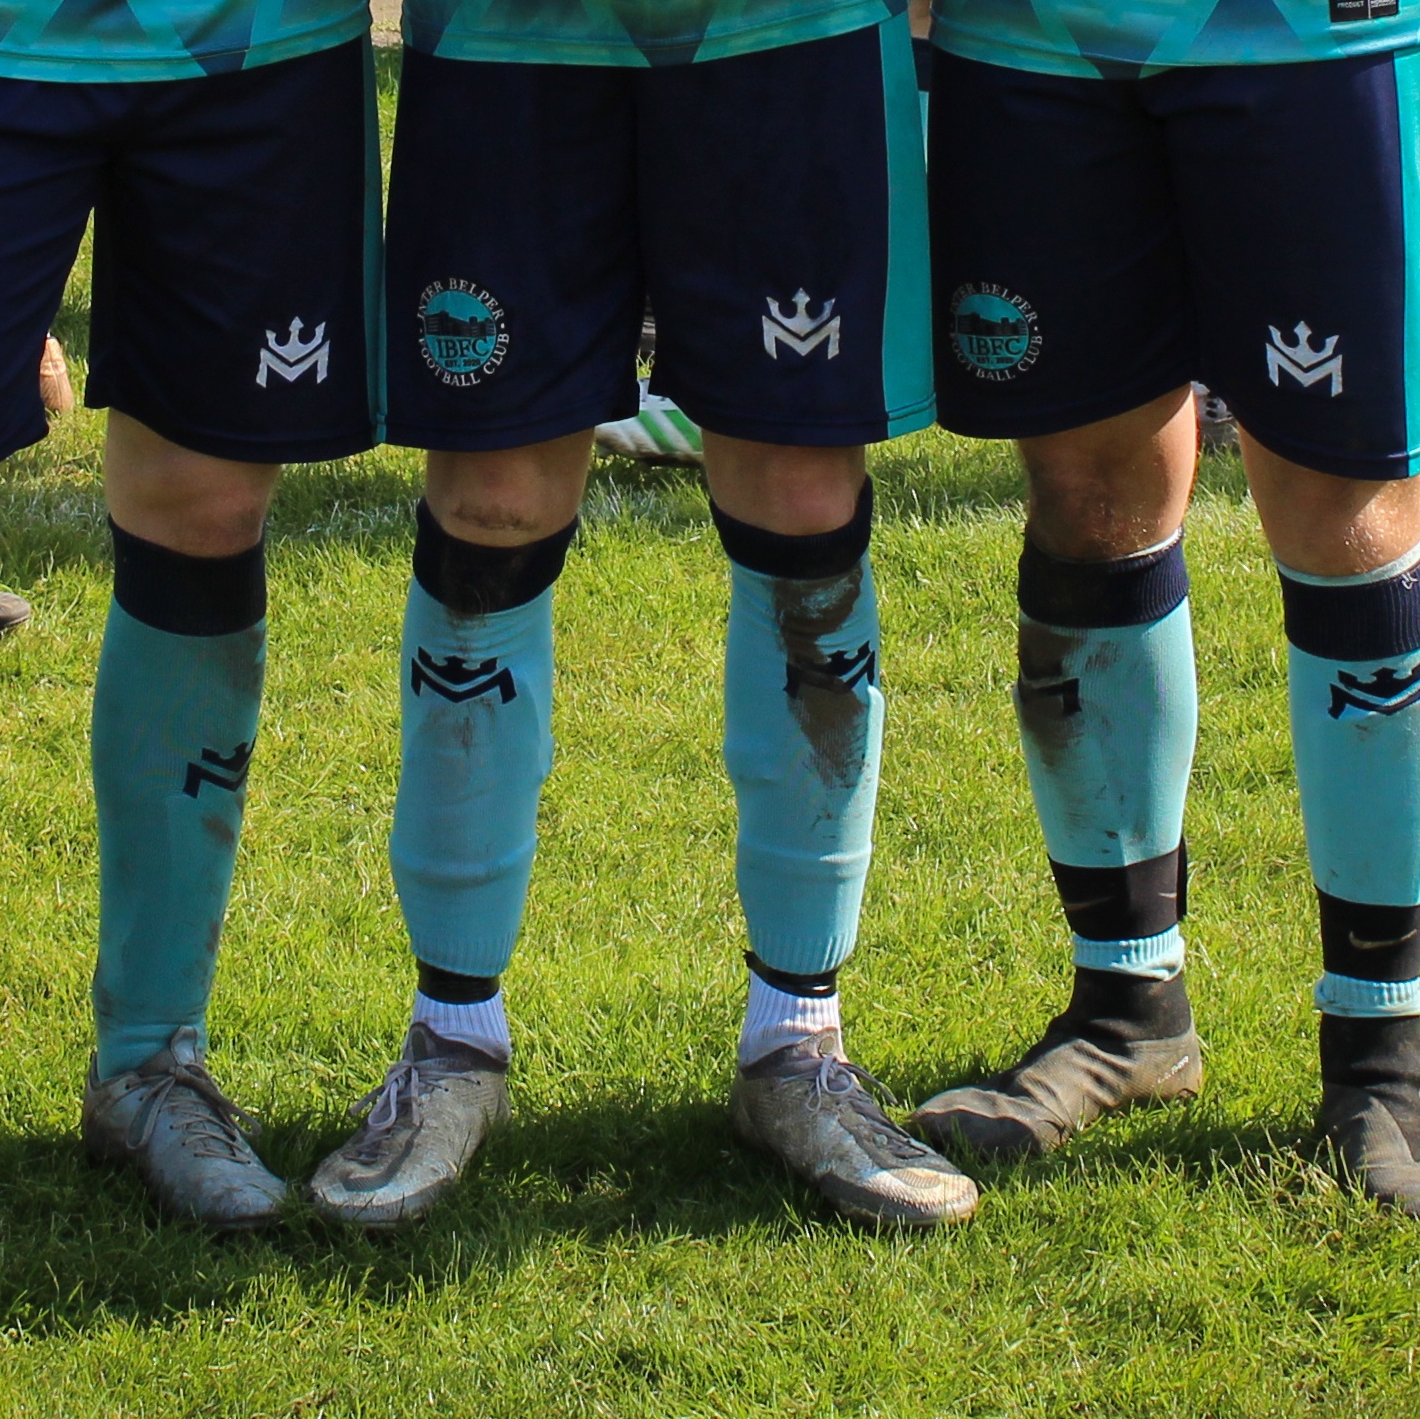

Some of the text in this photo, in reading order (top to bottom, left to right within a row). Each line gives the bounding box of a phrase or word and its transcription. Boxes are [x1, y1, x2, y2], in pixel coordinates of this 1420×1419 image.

[449, 278, 504, 320] BELPER
[981, 281, 1038, 323] BELPER
[435, 339, 489, 359] IBFC
[483, 333, 510, 375] CLUB
[967, 335, 1022, 355] IBFC
[1017, 335, 1043, 371] CLUB
